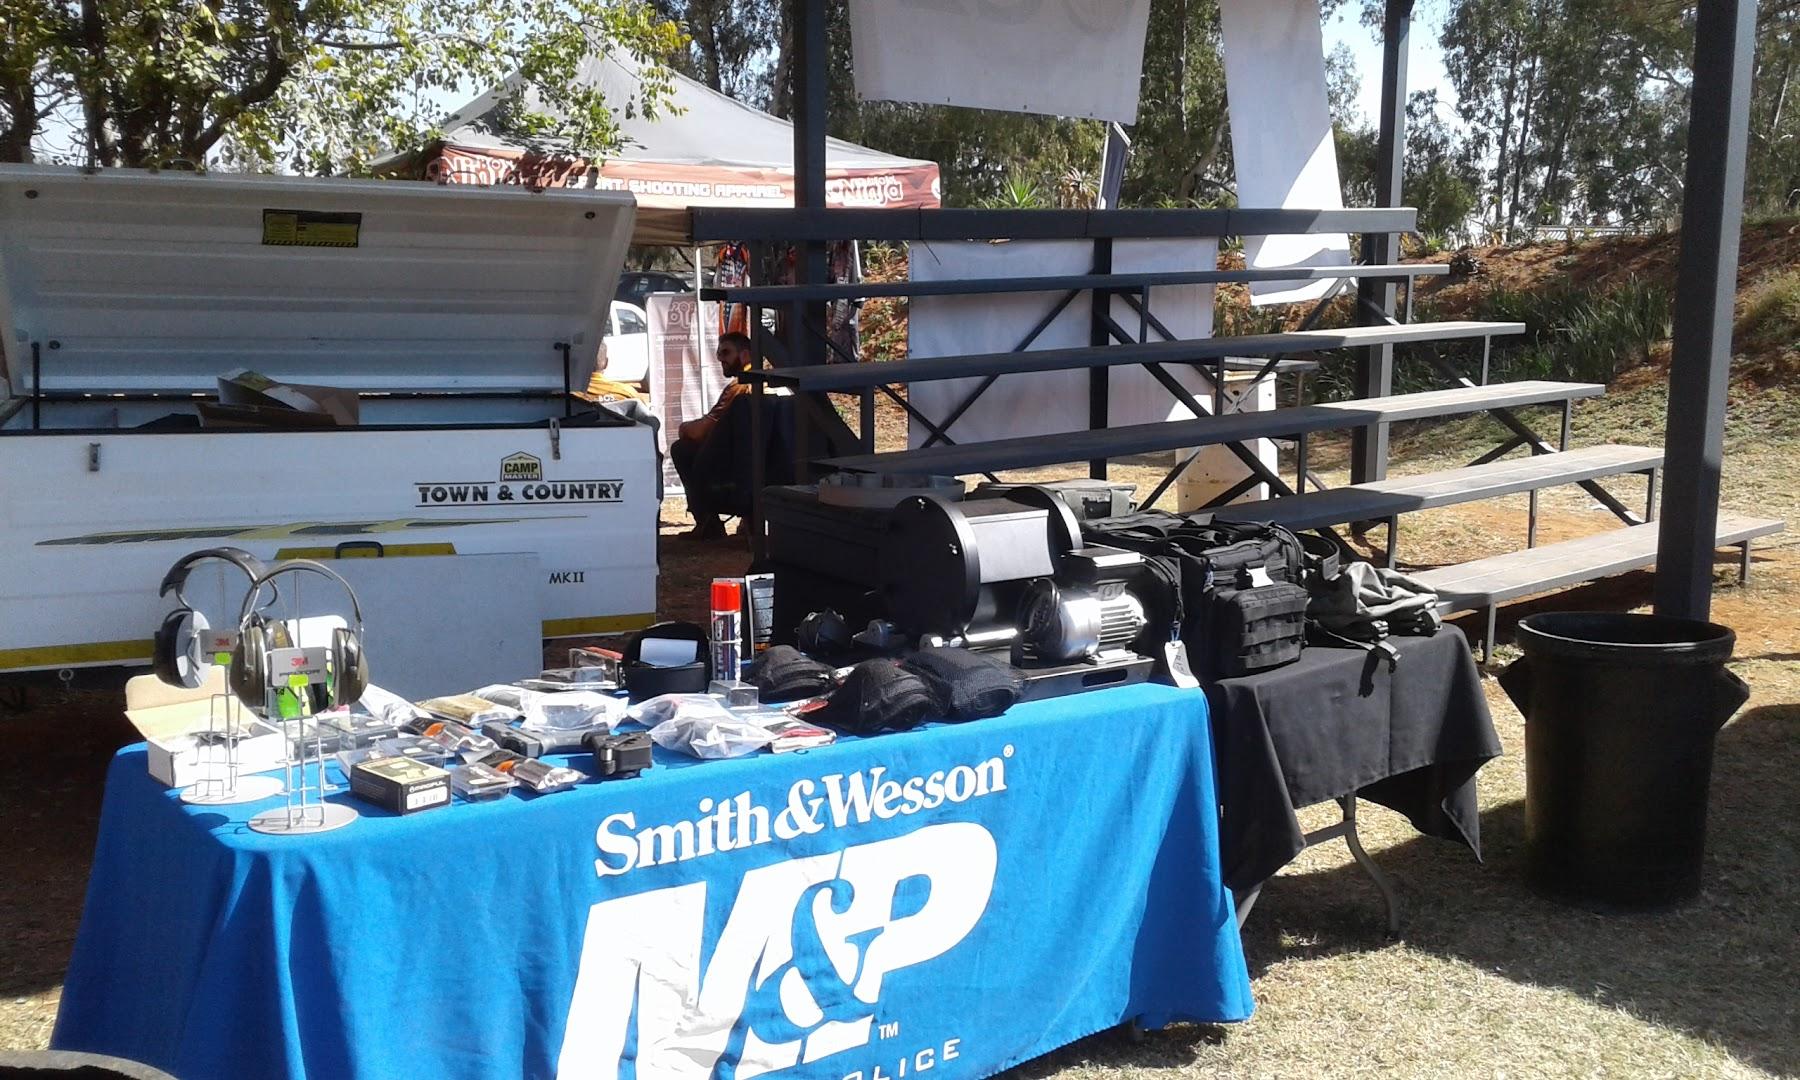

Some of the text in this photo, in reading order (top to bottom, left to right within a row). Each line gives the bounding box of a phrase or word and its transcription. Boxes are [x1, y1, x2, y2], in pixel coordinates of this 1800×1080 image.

[566, 176, 786, 199] SPRT SHOOTING APPAREL
[504, 462, 538, 473] CAMP
[418, 483, 625, 503] TOWN & COUNTRY
[291, 656, 310, 667] 3M
[878, 1021, 899, 1040] TM
[841, 1038, 961, 1080] LICE
